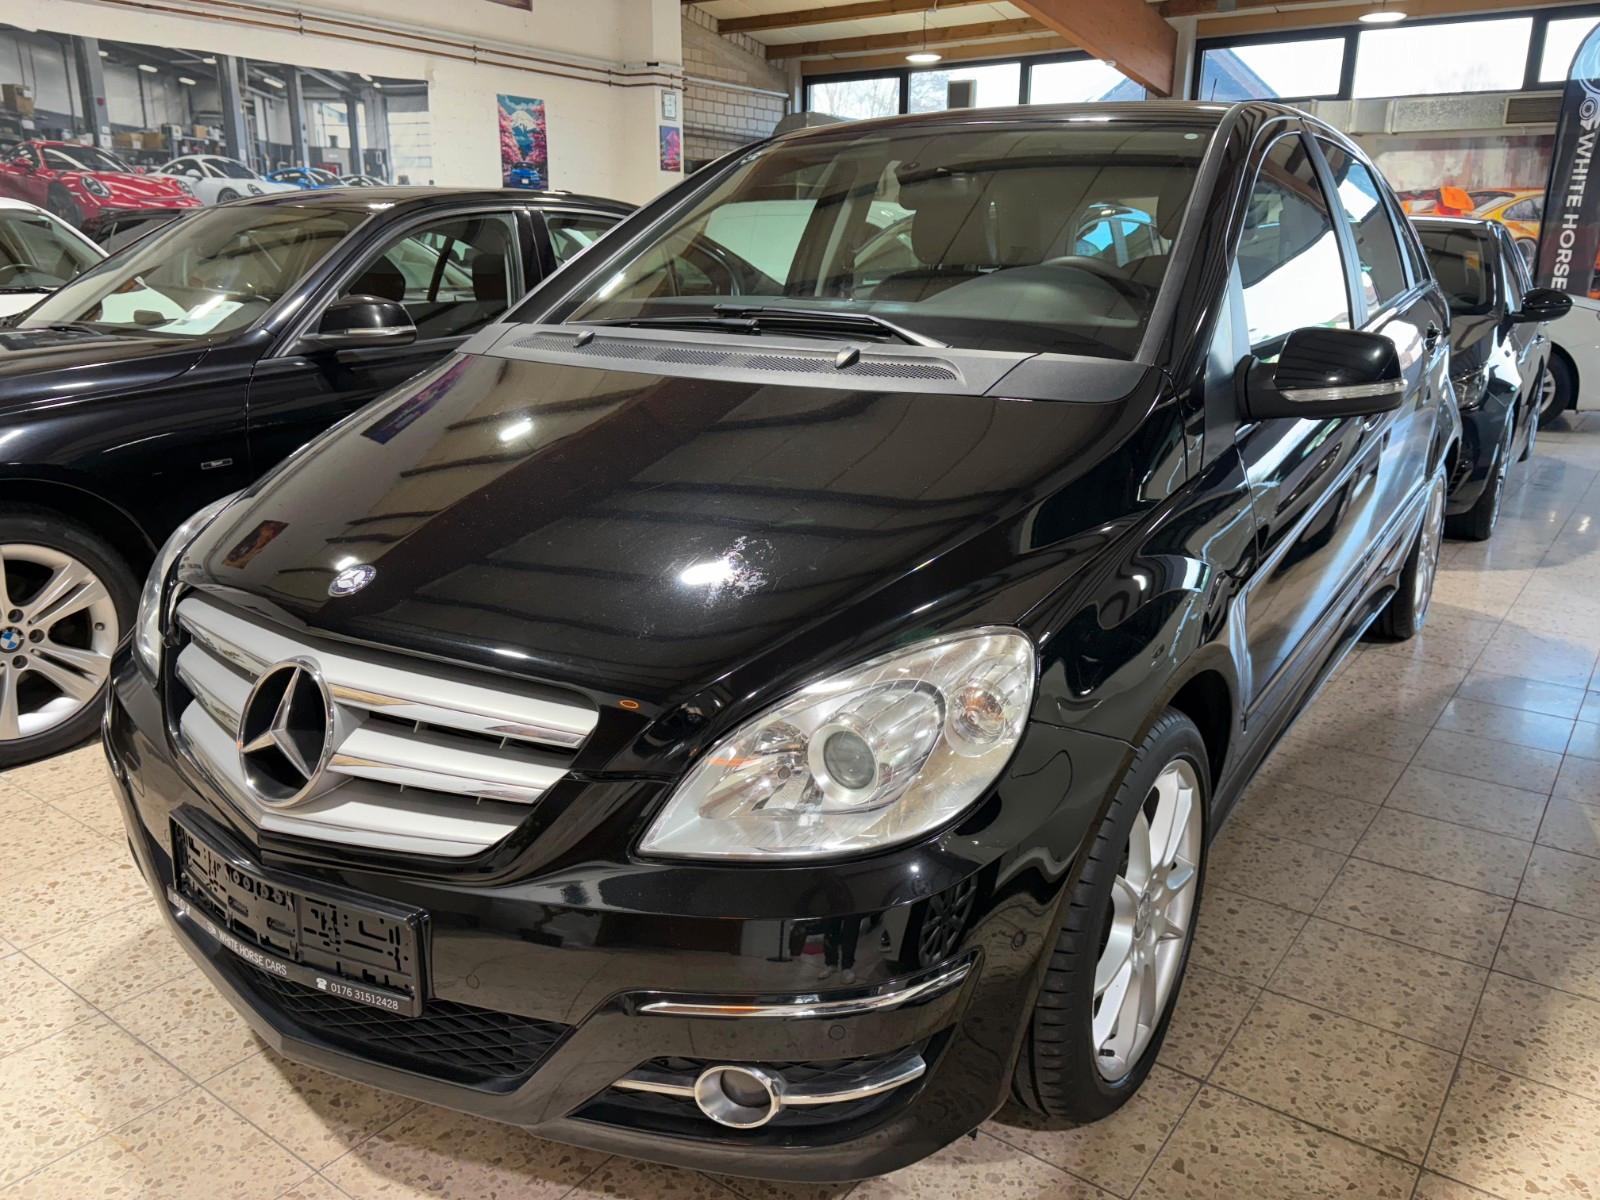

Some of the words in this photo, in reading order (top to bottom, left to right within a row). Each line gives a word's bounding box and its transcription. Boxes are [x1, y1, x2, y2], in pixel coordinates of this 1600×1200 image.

[1566, 132, 1596, 208] WHITE
[1550, 213, 1580, 290] HORSE
[219, 929, 240, 953] WHITE
[239, 943, 264, 967] HORSE
[265, 958, 288, 976] CARS
[330, 982, 353, 997] 0176
[354, 989, 399, 1010] 31512428
